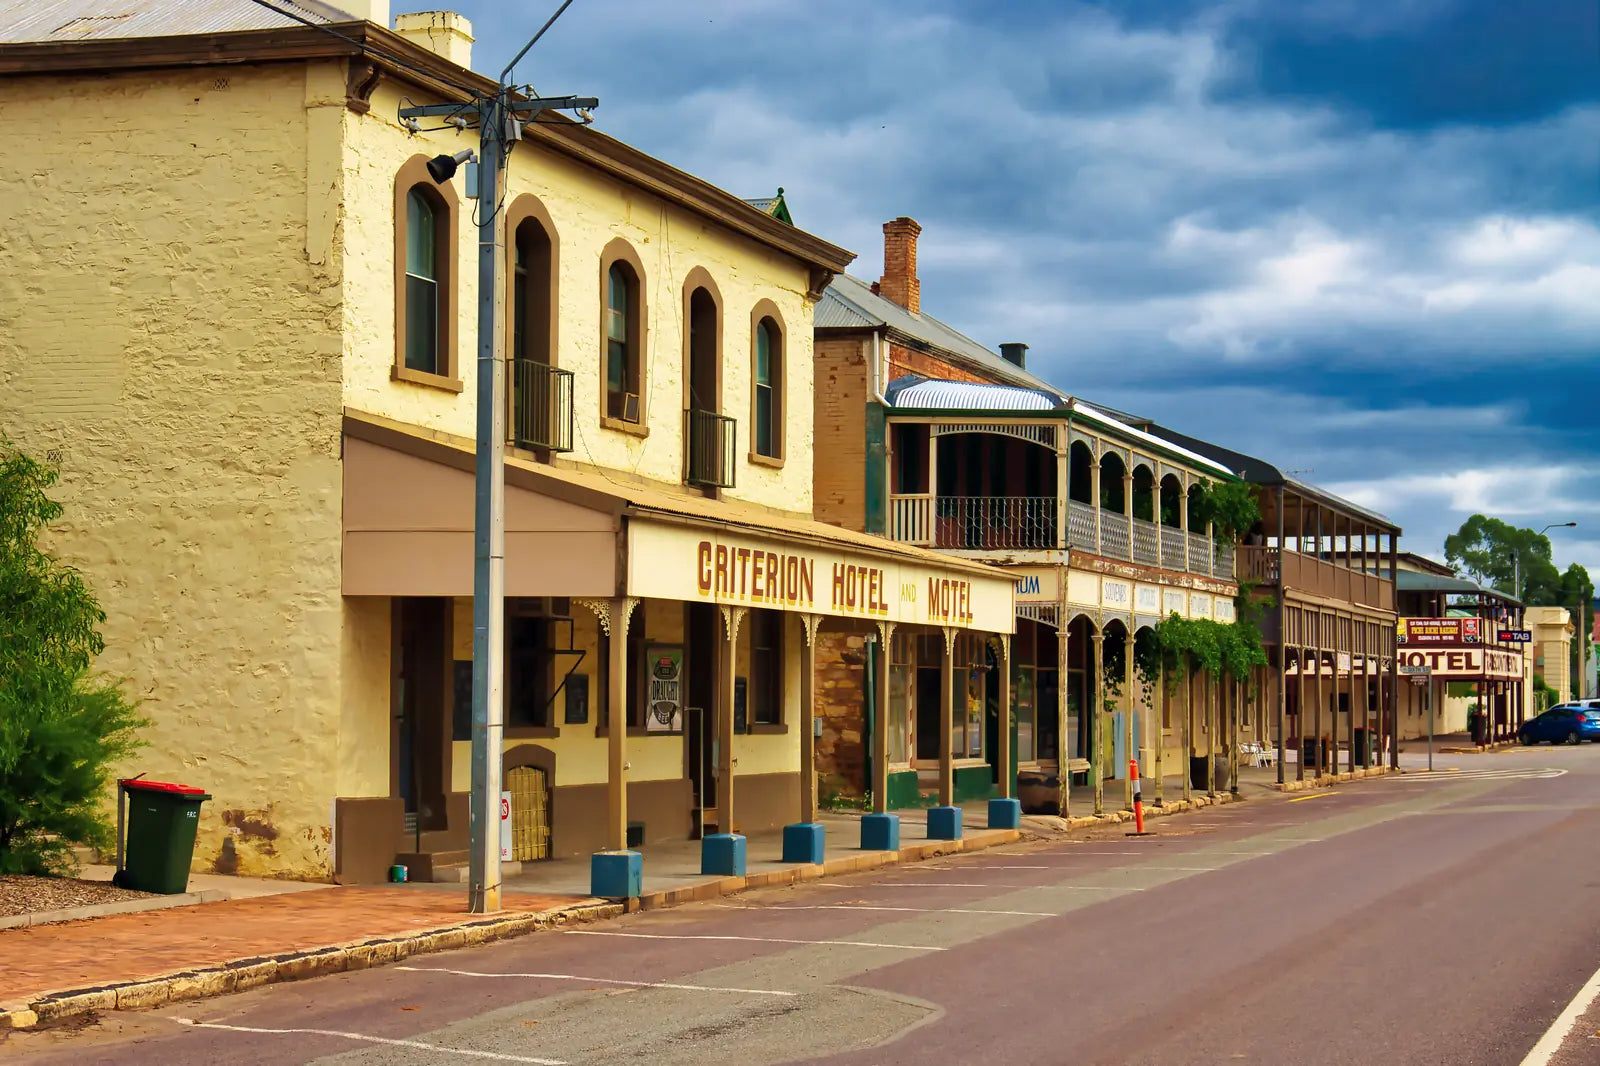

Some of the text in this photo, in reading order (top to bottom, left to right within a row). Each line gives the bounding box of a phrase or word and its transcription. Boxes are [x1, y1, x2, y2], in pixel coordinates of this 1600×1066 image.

[697, 540, 974, 624] CRITERION HOTEL AND MOTEL
[1512, 632, 1530, 641] TAB
[652, 680, 678, 701] DRAUGHT
